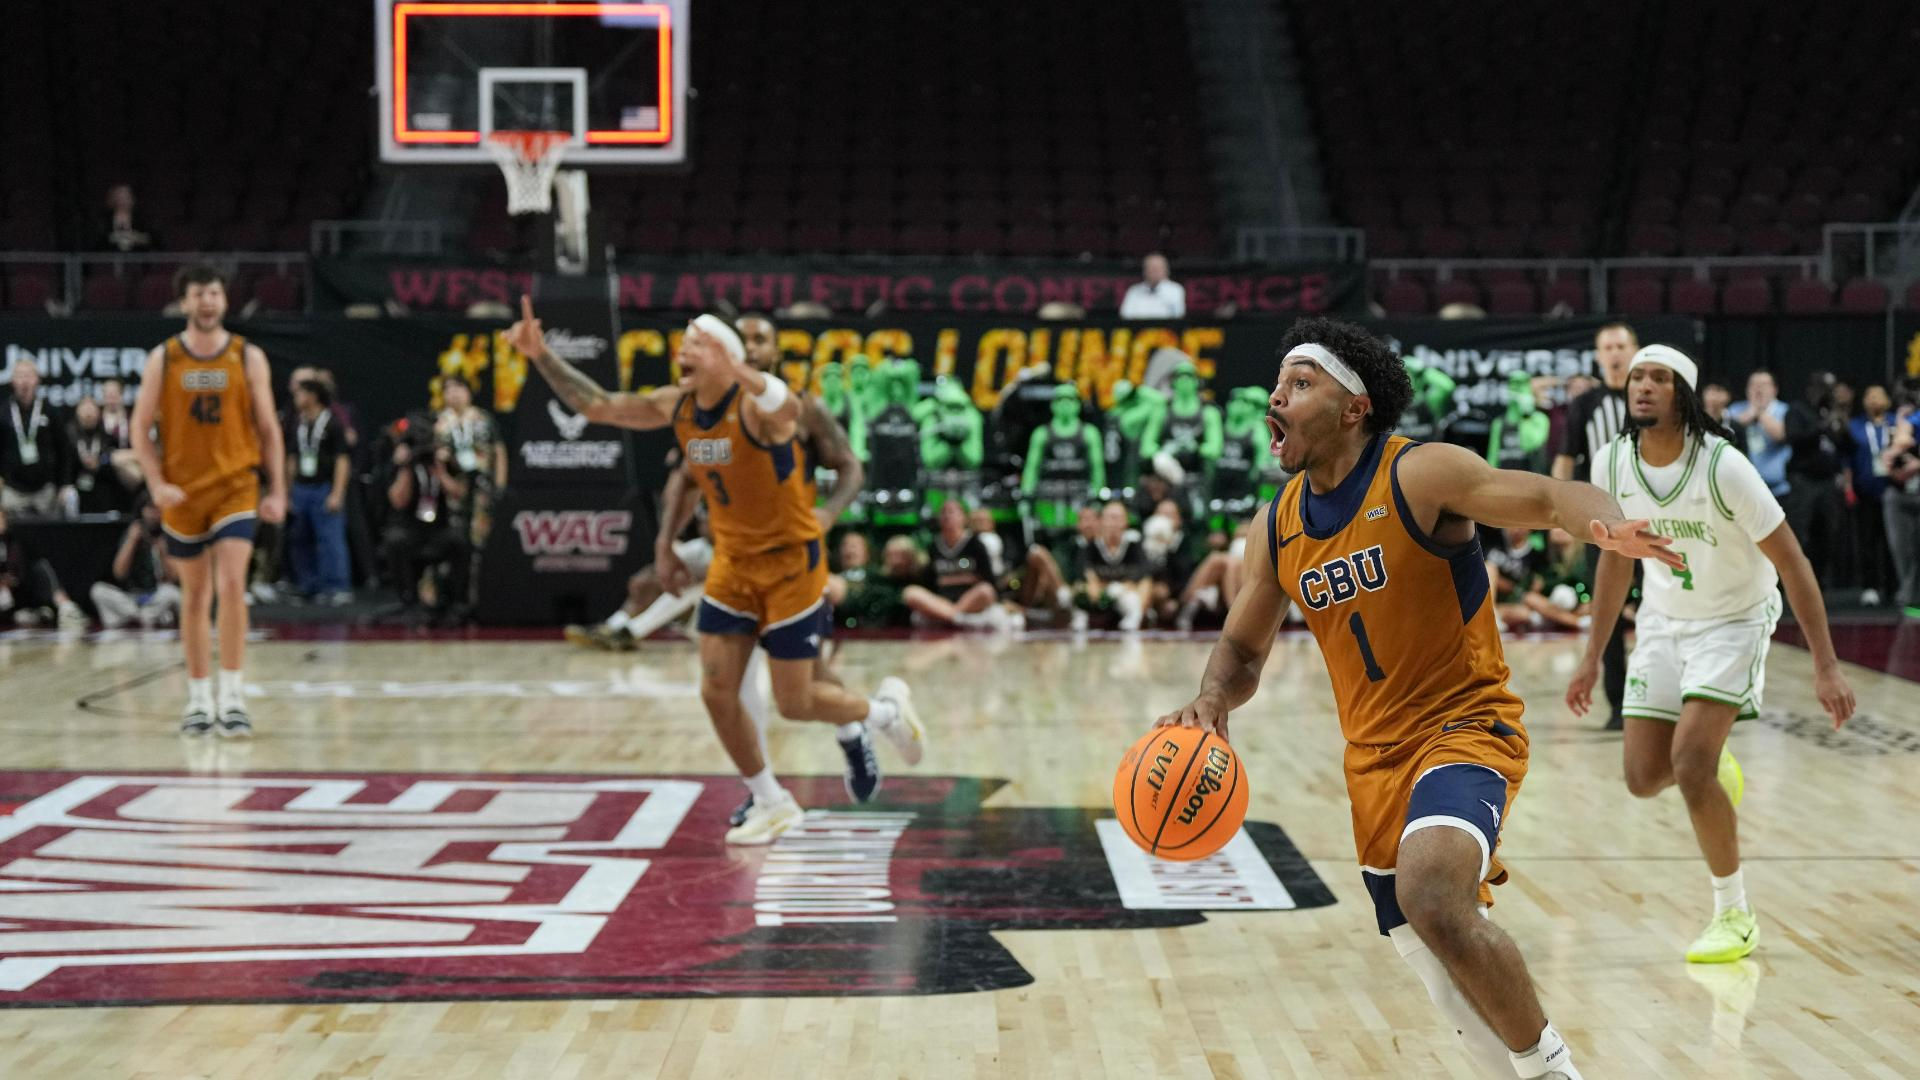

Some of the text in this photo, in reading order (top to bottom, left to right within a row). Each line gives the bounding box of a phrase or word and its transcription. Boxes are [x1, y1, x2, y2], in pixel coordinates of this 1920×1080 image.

[390, 270, 1331, 314] WESTN ATHLETIC CONFENCE
[189, 394, 222, 425] 42
[686, 437, 733, 465] CBU
[513, 510, 633, 555] WAC
[1365, 504, 1388, 521] WAC
[1649, 518, 1718, 547] VERINES
[1299, 544, 1389, 611] CBU
[1349, 611, 1388, 683] 1
[1147, 740, 1180, 791] EVO
[1177, 746, 1230, 825] Wilson
